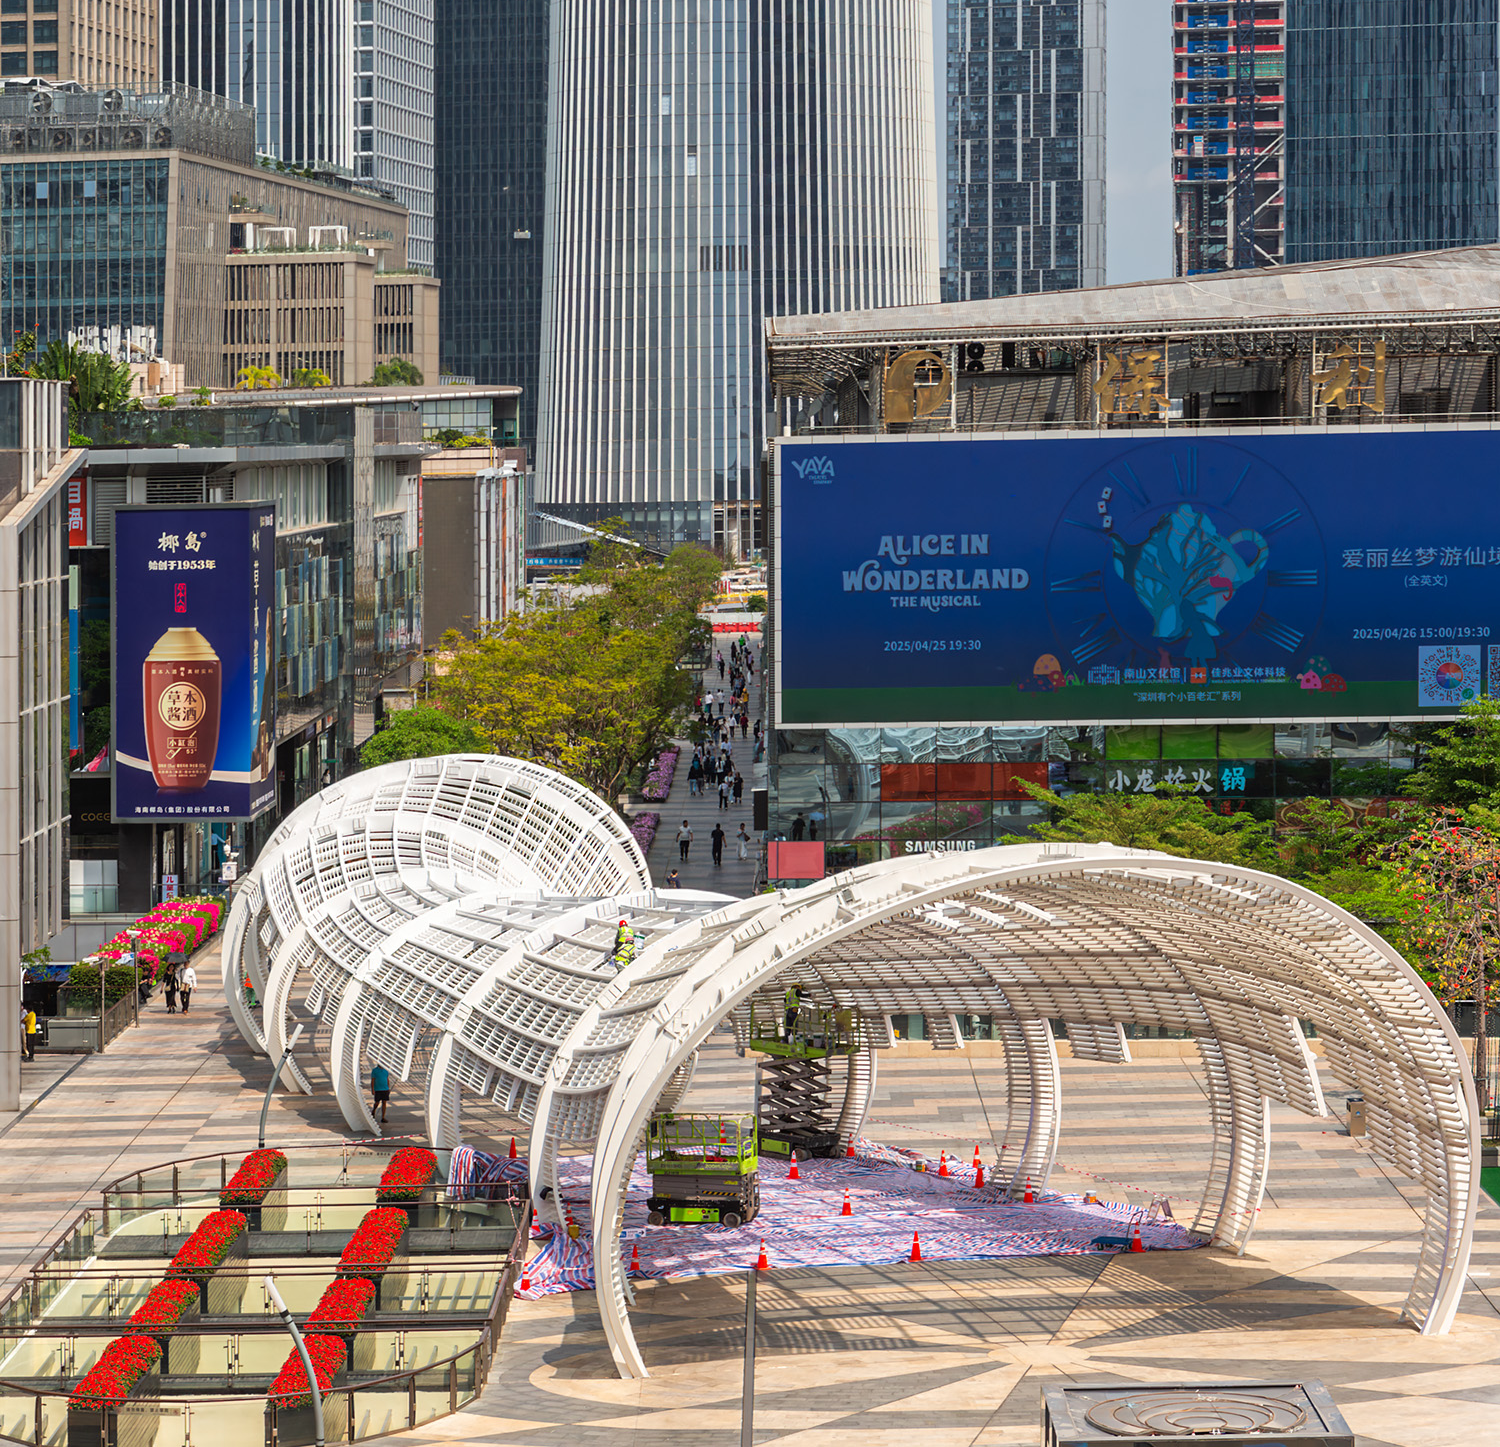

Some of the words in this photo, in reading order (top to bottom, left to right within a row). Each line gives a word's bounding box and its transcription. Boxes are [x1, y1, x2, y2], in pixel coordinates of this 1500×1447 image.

[791, 455, 835, 479] YAYA
[877, 534, 955, 566] ALICE
[961, 533, 990, 556] IN
[148, 559, 217, 571] 始创于1953年
[843, 559, 1030, 593] WONDERLAND
[890, 596, 917, 608] THE
[920, 595, 981, 612] MUSICAL
[1353, 627, 1416, 640] 2025/04/26
[1419, 626, 1490, 639] 15:00/19:30
[884, 640, 946, 652] 2025/04/25
[949, 639, 982, 651] 19:30
[1124, 667, 1181, 679] 南山文化馆
[1211, 666, 1287, 677] 佳兆业文体科技
[905, 840, 976, 852] SAMSUNG
